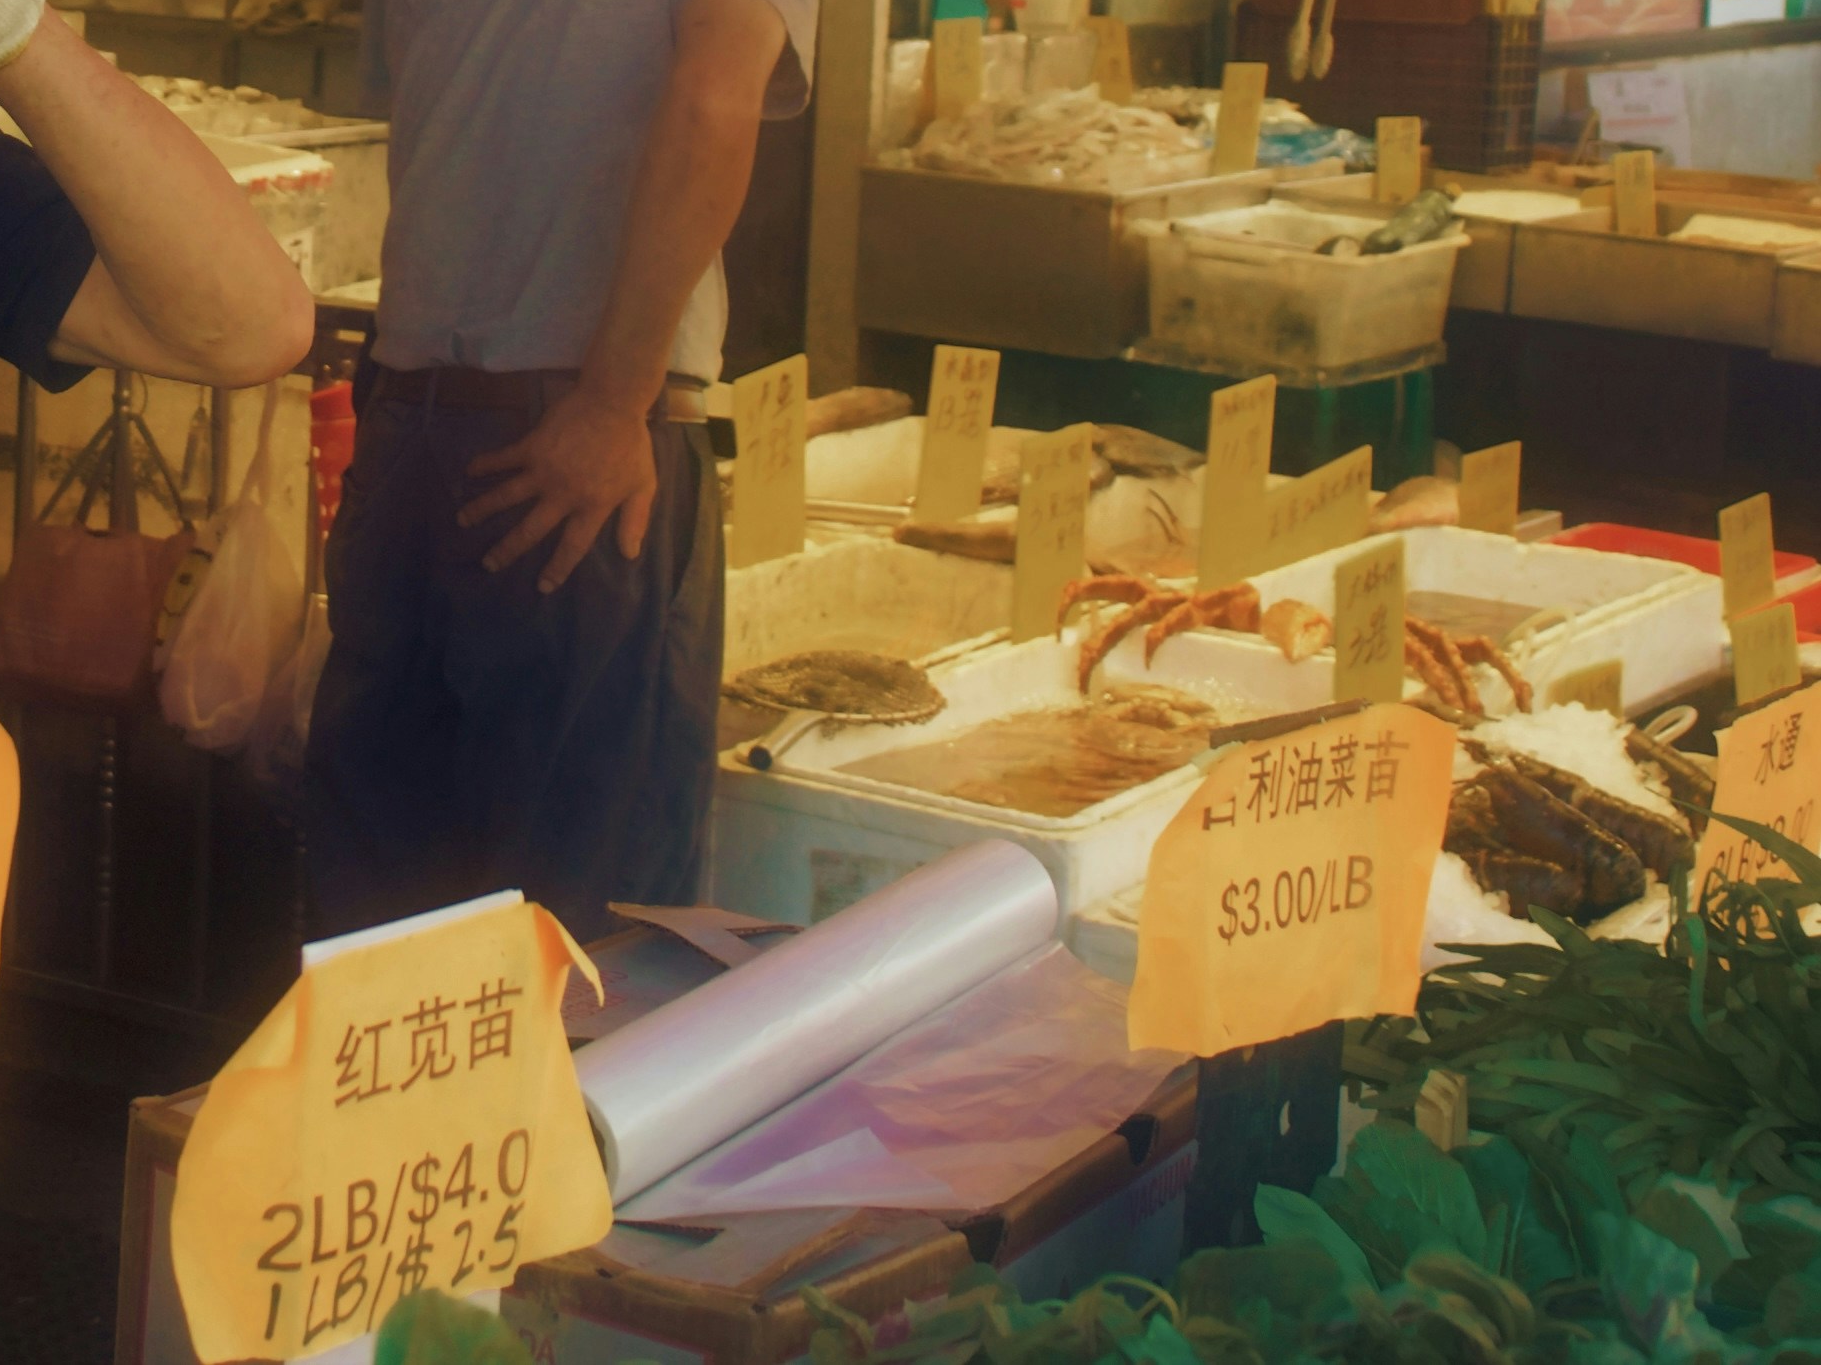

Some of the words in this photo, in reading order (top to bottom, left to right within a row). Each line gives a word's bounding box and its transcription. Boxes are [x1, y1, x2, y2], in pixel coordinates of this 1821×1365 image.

[1217, 854, 1375, 947] $3.00/LB
[334, 977, 525, 1109] 红苋苗
